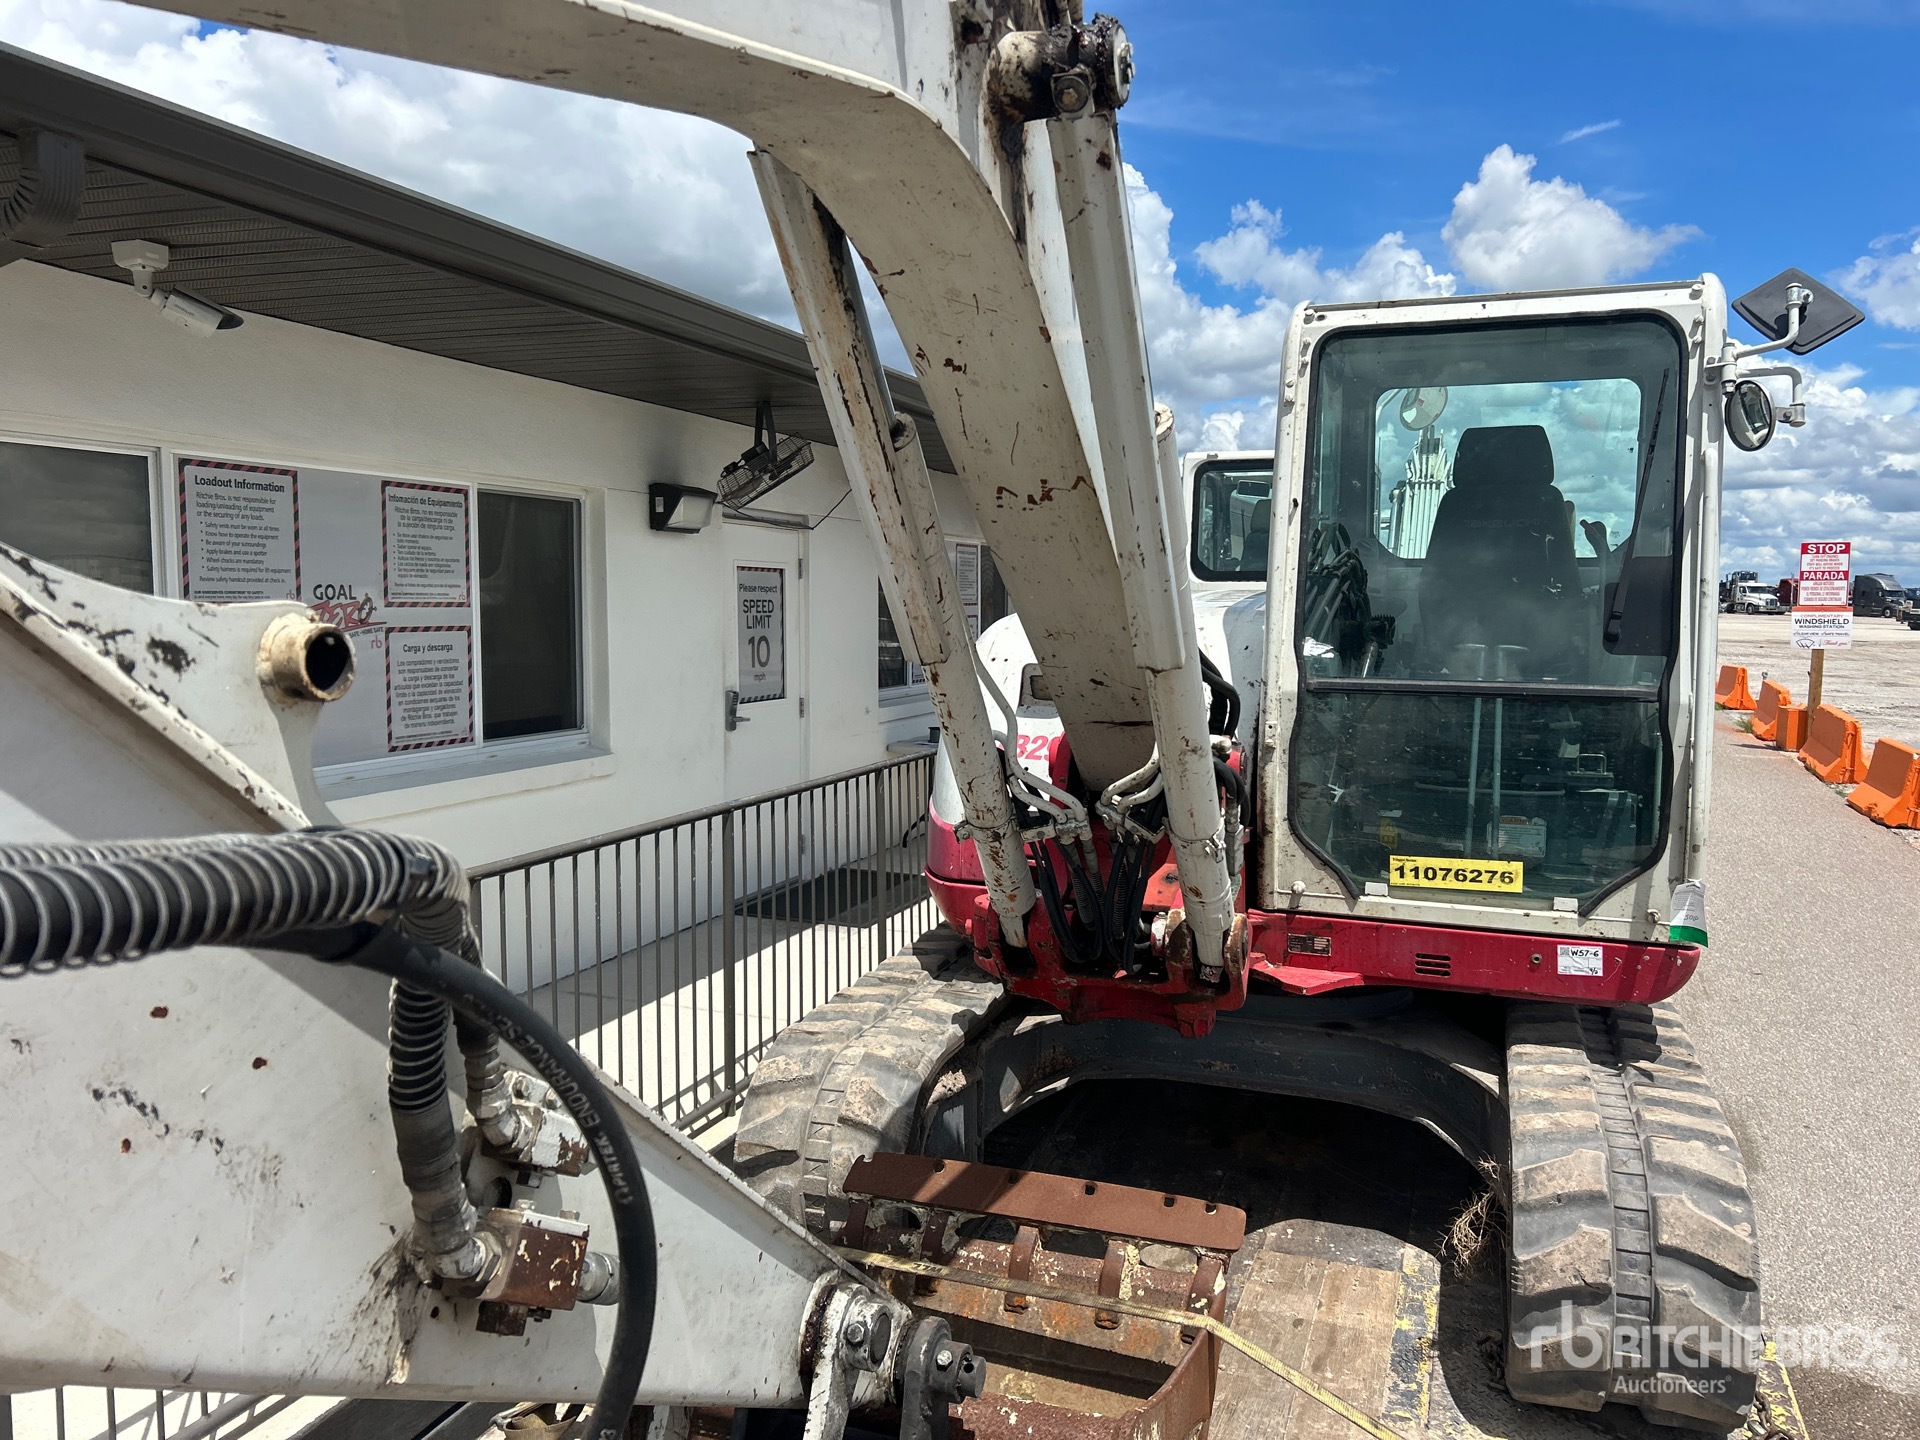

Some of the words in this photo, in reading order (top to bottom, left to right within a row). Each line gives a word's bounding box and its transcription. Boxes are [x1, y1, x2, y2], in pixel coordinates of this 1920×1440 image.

[195, 475, 233, 488] Loadout
[235, 479, 284, 492] Information
[428, 497, 463, 508] Equipamiento
[1808, 544, 1846, 553] STOP
[313, 584, 357, 600] GOAL
[739, 583, 757, 592] Please
[758, 585, 778, 594] respect
[743, 599, 774, 614] SPEED
[746, 615, 772, 629] LIMIT
[403, 644, 420, 654] Carga
[427, 644, 453, 652] descarga
[748, 635, 770, 668] 10
[754, 672, 766, 682] mph
[1395, 865, 1514, 884] 11076276
[518, 1033, 602, 1129] ENDURANCE
